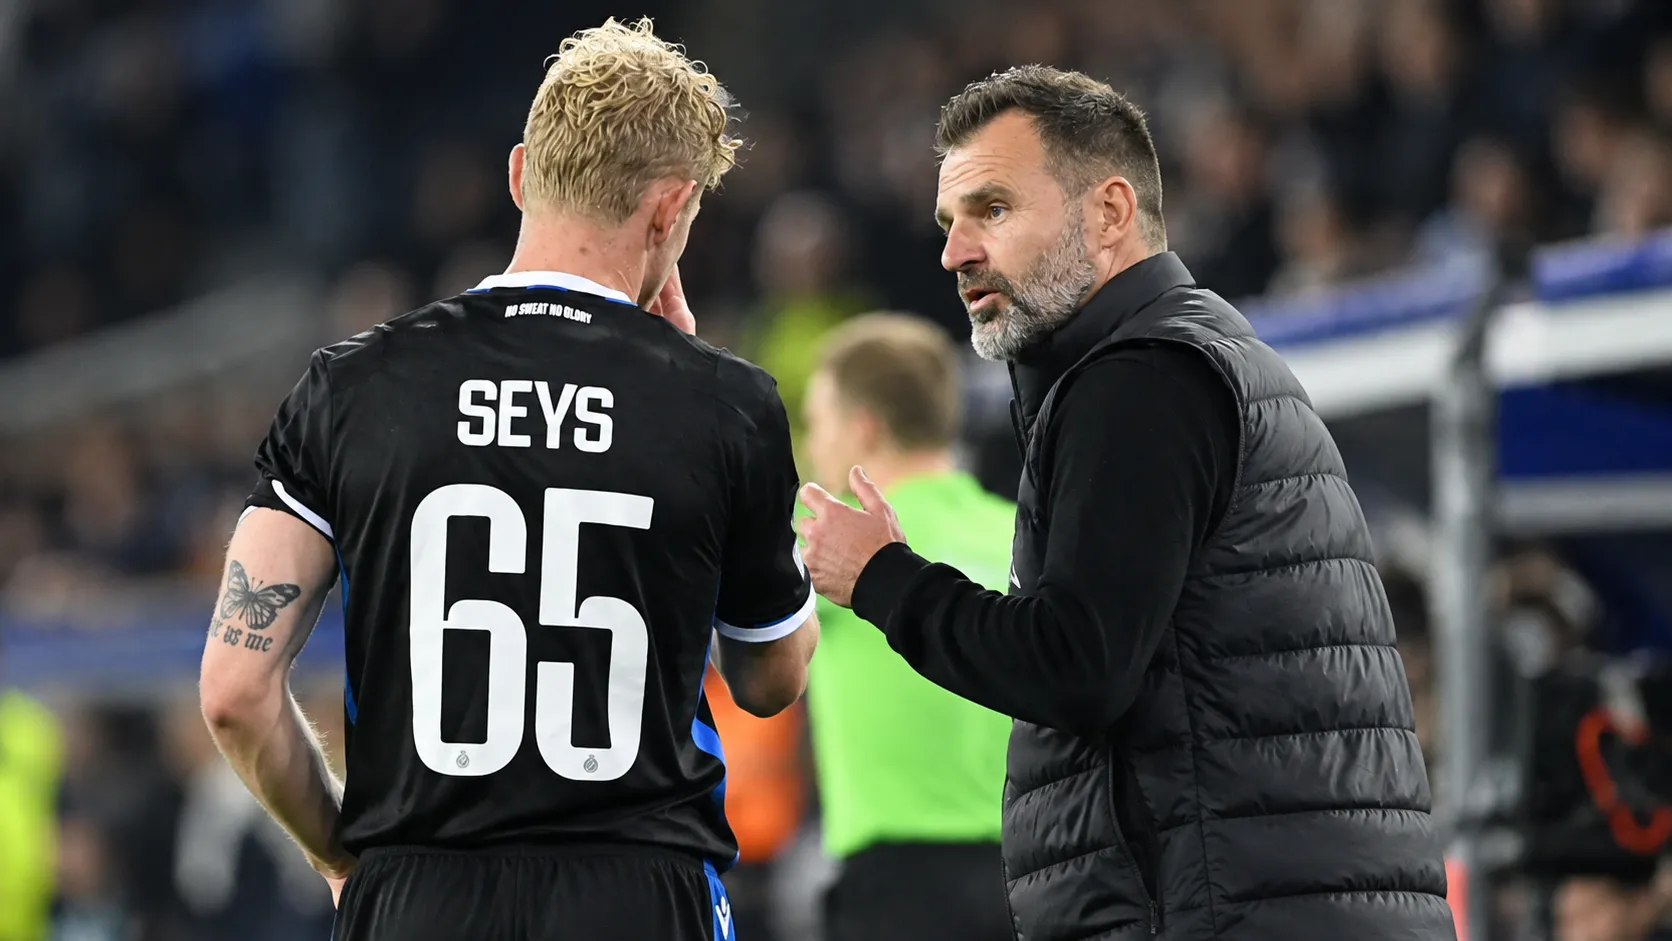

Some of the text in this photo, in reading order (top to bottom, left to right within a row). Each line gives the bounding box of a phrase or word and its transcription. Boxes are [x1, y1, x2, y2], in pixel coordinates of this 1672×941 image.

[504, 302, 592, 324] NO SWEAT NO GLORY
[457, 379, 615, 453] SEYS
[244, 631, 273, 652] me
[409, 483, 655, 781] 65
